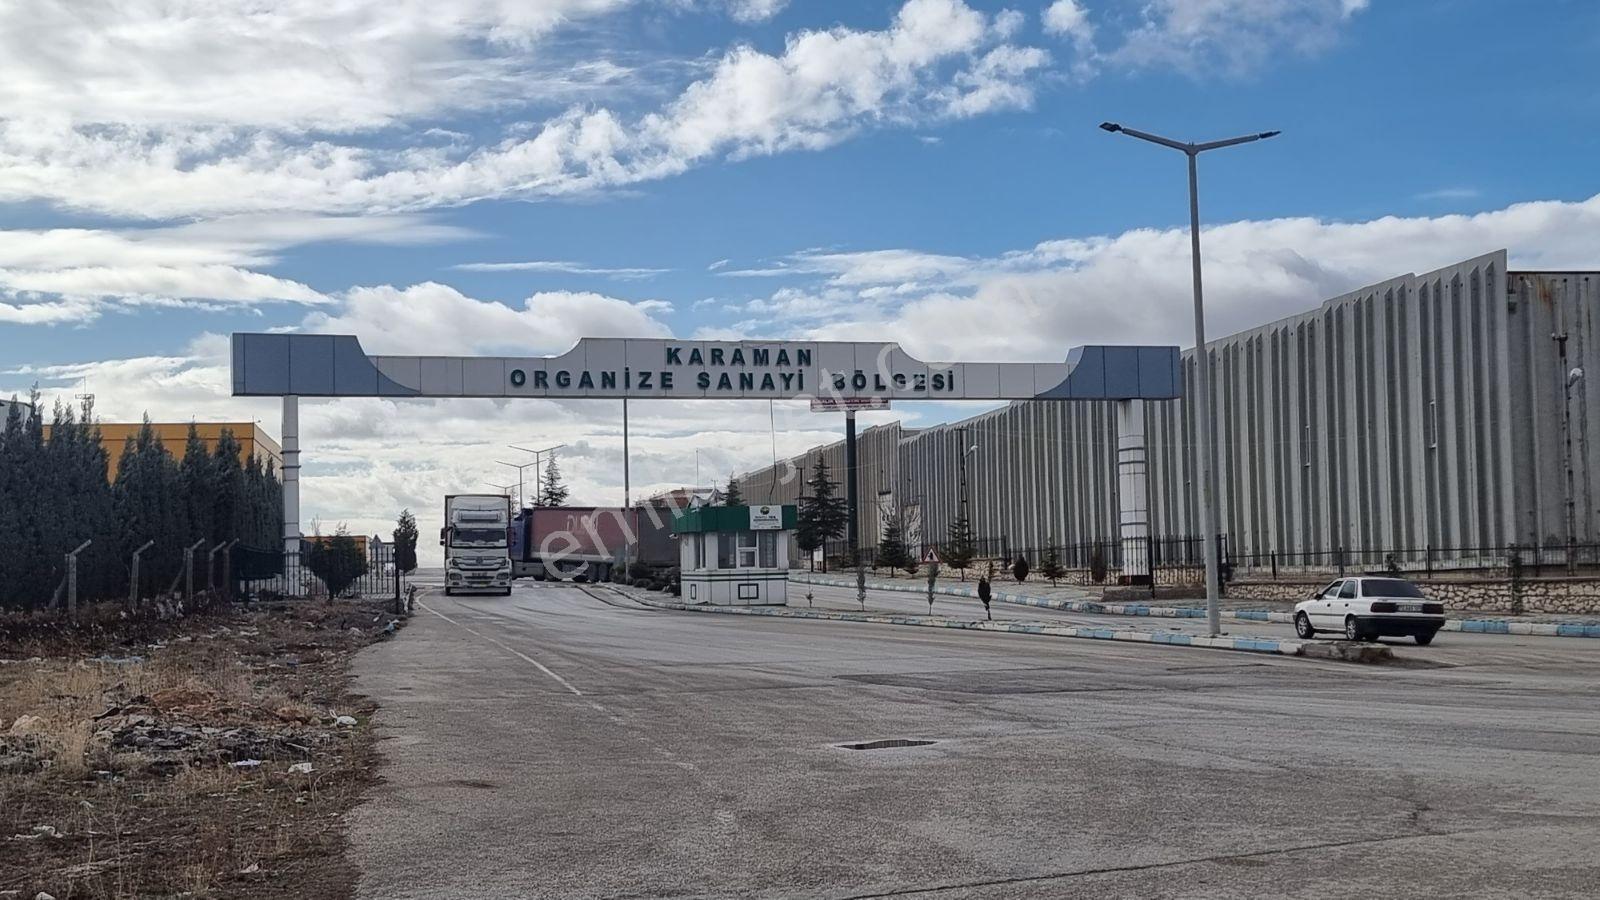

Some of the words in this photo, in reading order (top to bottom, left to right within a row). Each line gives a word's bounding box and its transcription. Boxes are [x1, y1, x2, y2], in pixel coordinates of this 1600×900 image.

[666, 347, 812, 367] KARAMAN
[510, 367, 673, 390] ORGANİZE
[697, 369, 804, 391] SANAYİ
[832, 370, 954, 391] BÖLGESİ
